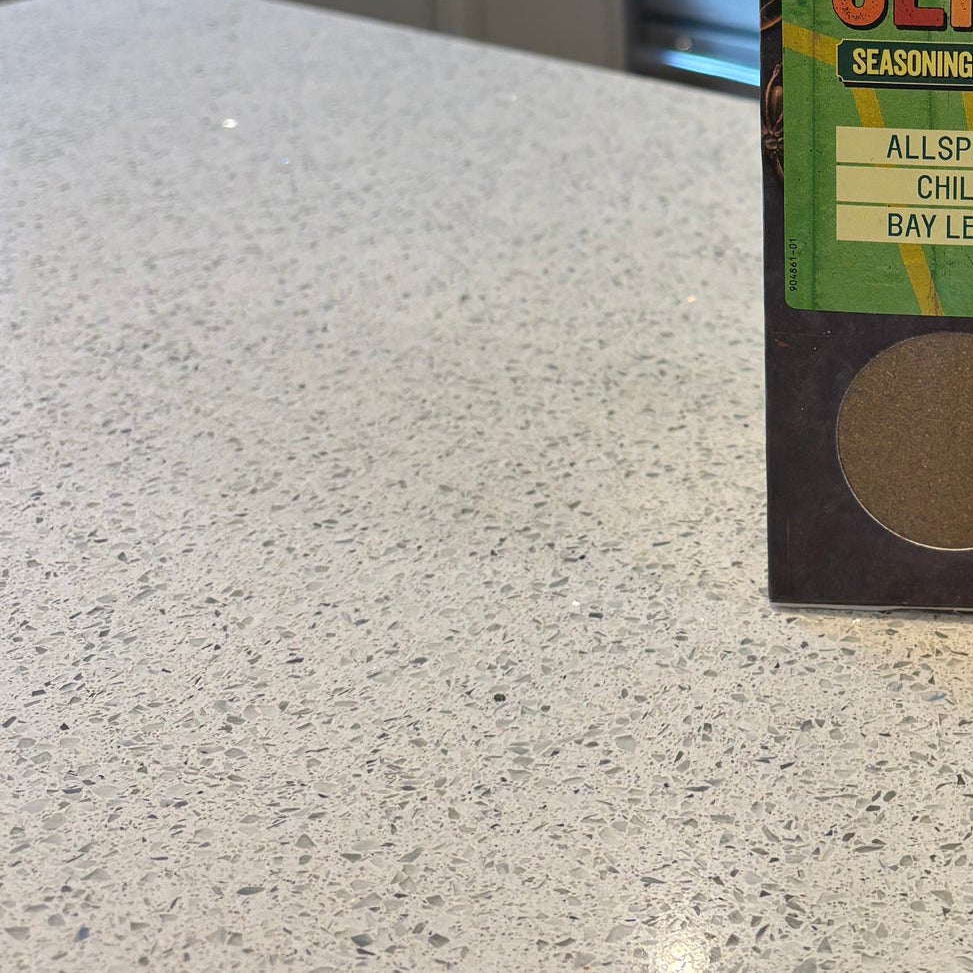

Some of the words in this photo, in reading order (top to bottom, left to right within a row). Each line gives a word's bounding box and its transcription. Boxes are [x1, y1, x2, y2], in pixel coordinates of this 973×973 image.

[852, 47, 973, 78] SEASONING
[888, 213, 936, 238] BAY
[789, 237, 798, 292] 904861-01
